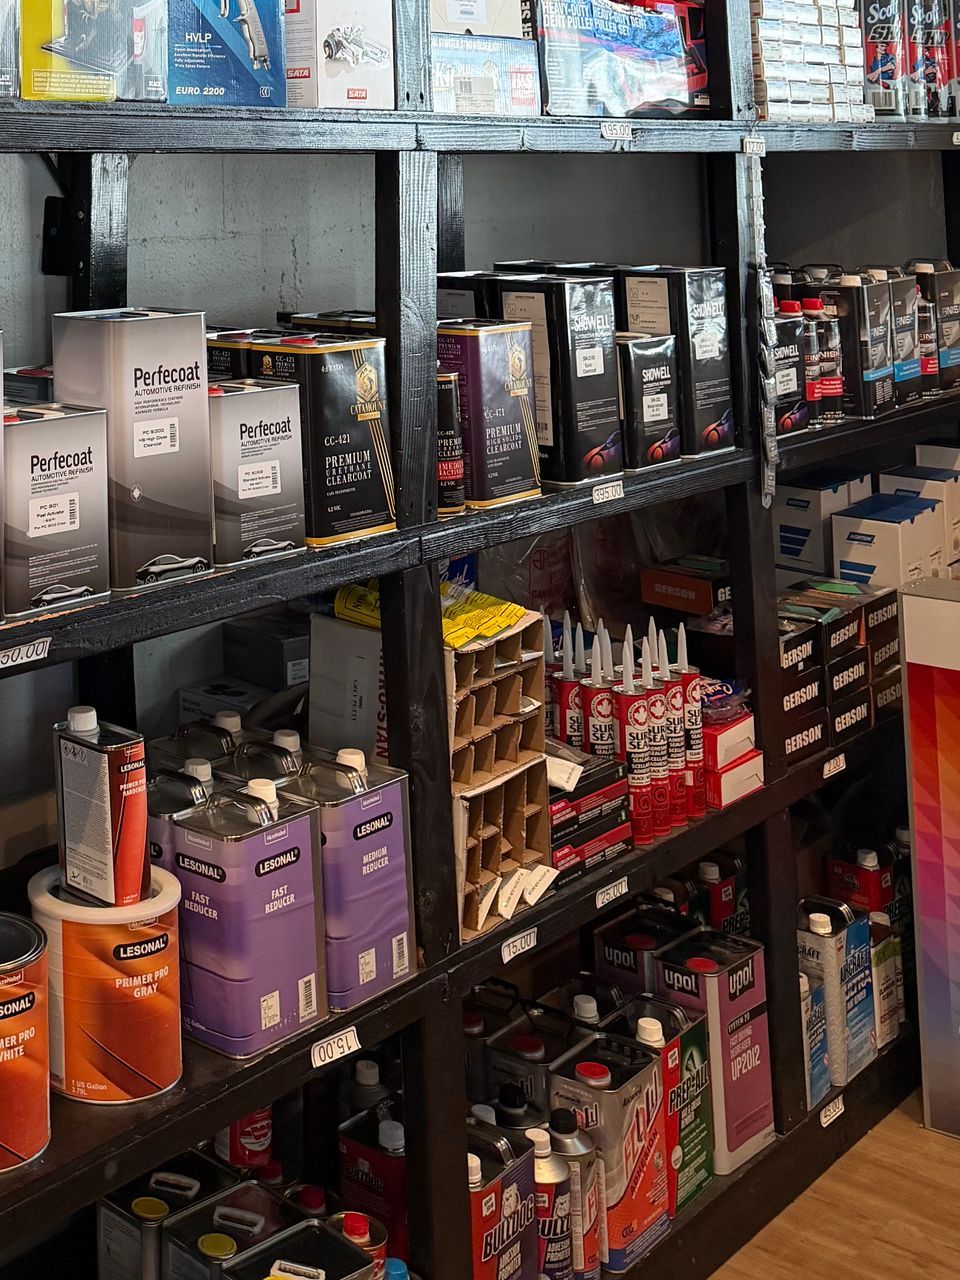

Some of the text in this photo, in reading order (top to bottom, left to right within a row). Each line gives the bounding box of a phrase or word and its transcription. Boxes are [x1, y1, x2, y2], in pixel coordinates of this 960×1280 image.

[592, 5, 647, 30] HEAVY-DUTY DENT
[185, 32, 212, 43] HVLP
[175, 86, 225, 96] EURO 2200
[604, 124, 630, 137] 195.00
[134, 360, 201, 389] Perfecoat
[641, 366, 671, 383] SHOWELL
[324, 433, 351, 447] CC-421
[325, 450, 371, 469] PREMIUM
[325, 462, 372, 477] URETHANE
[326, 470, 372, 487] CLEARCOAT
[594, 484, 623, 500] 395.00
[867, 601, 898, 628] GERSON
[830, 619, 859, 649] GERSON
[782, 641, 813, 670] GERSON
[783, 682, 819, 713] GERSON
[356, 814, 392, 836] LESONAL
[258, 850, 298, 875] LESONAL
[362, 846, 388, 863] MEDIUM
[361, 857, 390, 876] REDUCER
[264, 891, 295, 914] REDUCER
[270, 885, 289, 900] FAST
[601, 883, 624, 905] 25.00
[118, 935, 167, 959] LESONAL
[504, 932, 534, 958] 15.00
[115, 966, 170, 990] PRIMER PRO
[664, 968, 699, 994] upol
[728, 959, 754, 996] upol
[132, 981, 159, 999] GRAY
[17, 1028, 36, 1044] PRO
[317, 1031, 354, 1061] 15.00
[731, 1045, 761, 1081] UP2012
[667, 1062, 711, 1117] PREP-ALL
[482, 1192, 535, 1262] BULLDOG
